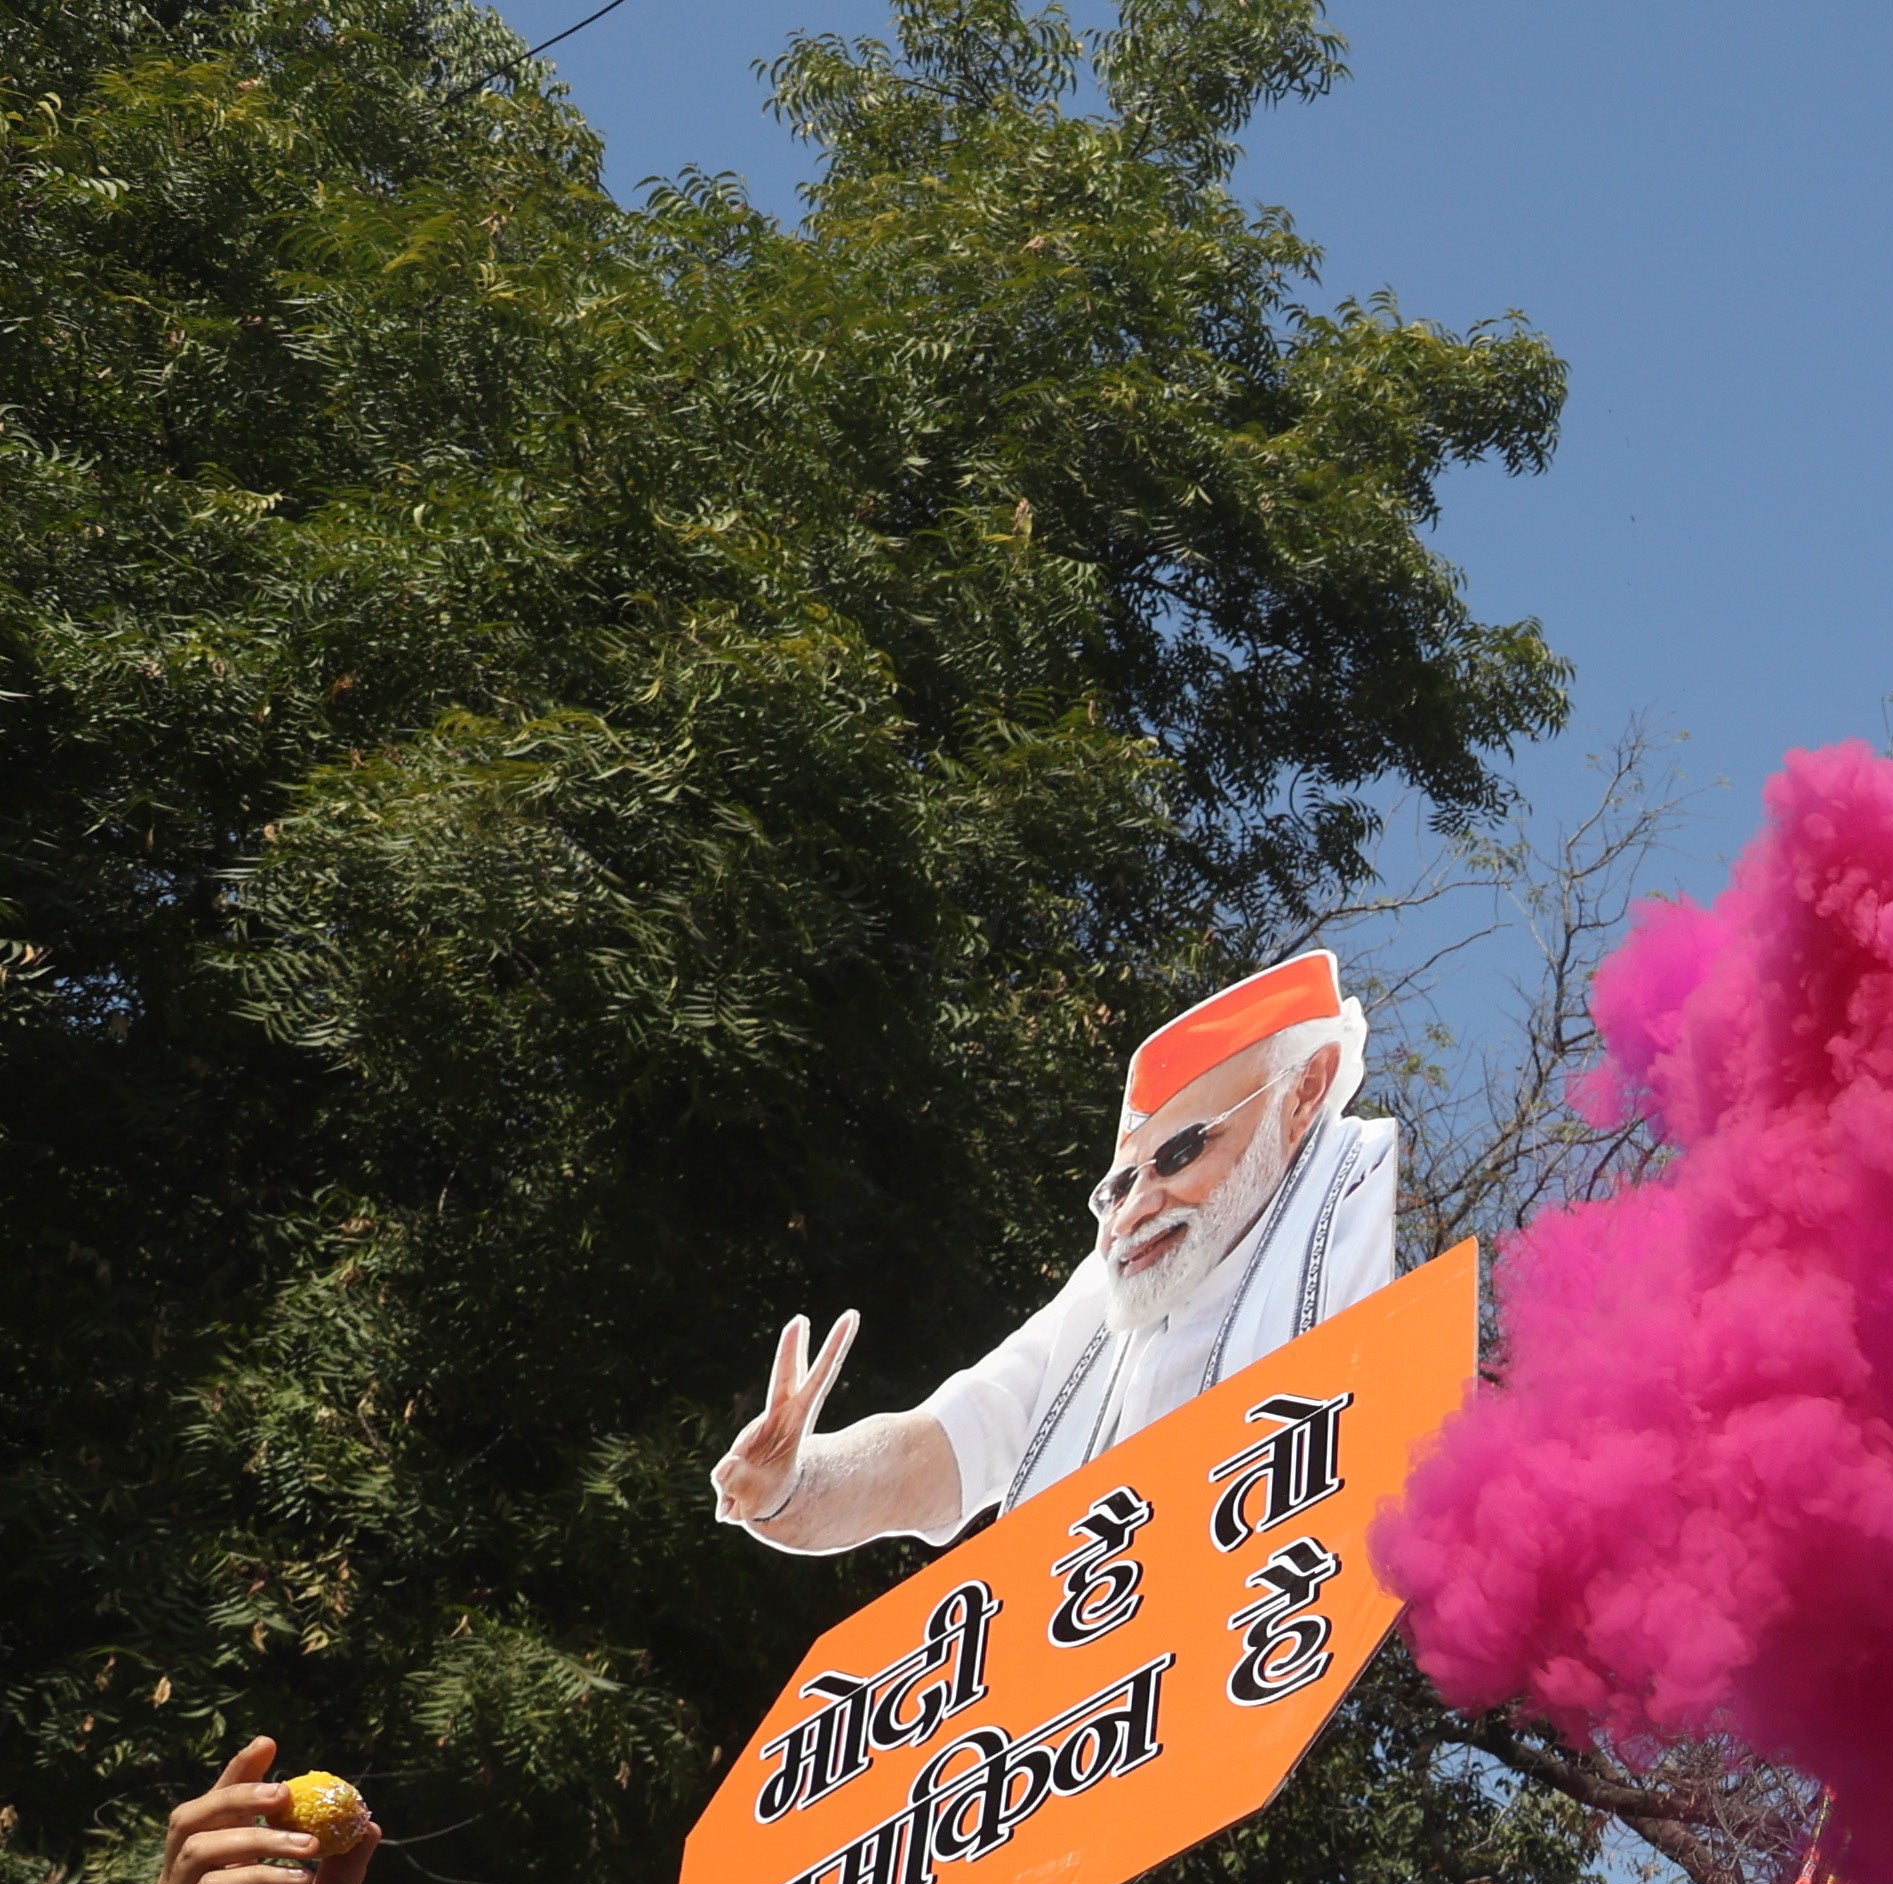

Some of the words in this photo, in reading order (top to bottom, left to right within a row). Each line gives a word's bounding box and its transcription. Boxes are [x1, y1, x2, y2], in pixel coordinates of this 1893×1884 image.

[755, 1579, 1003, 1825] मोदी
[1048, 1484, 1153, 1649] है
[1209, 1391, 1354, 1553] तो
[1226, 1536, 1340, 1708] है
